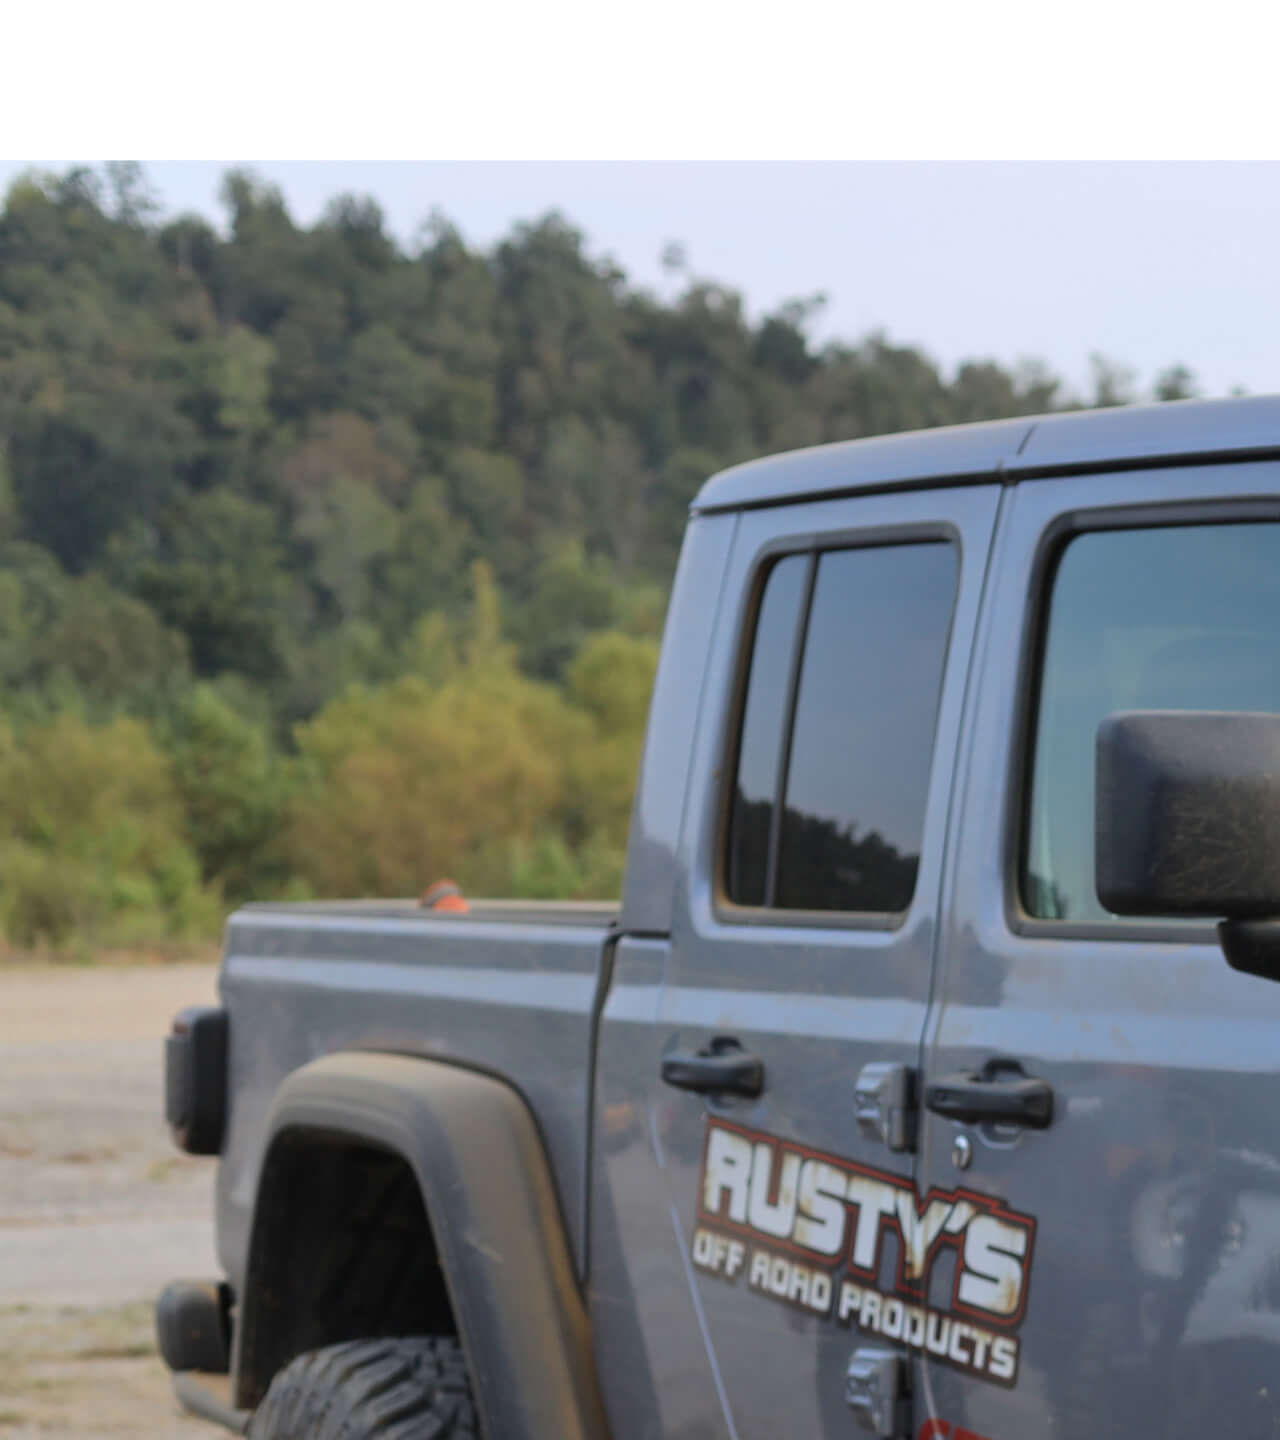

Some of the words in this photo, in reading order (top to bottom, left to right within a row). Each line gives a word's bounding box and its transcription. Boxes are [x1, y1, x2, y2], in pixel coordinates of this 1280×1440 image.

[692, 1229, 744, 1275] OFF
[750, 1249, 833, 1312] ROAD
[839, 1281, 1018, 1380] PRODUCTS
[703, 1126, 1028, 1316] RUSTY'S
